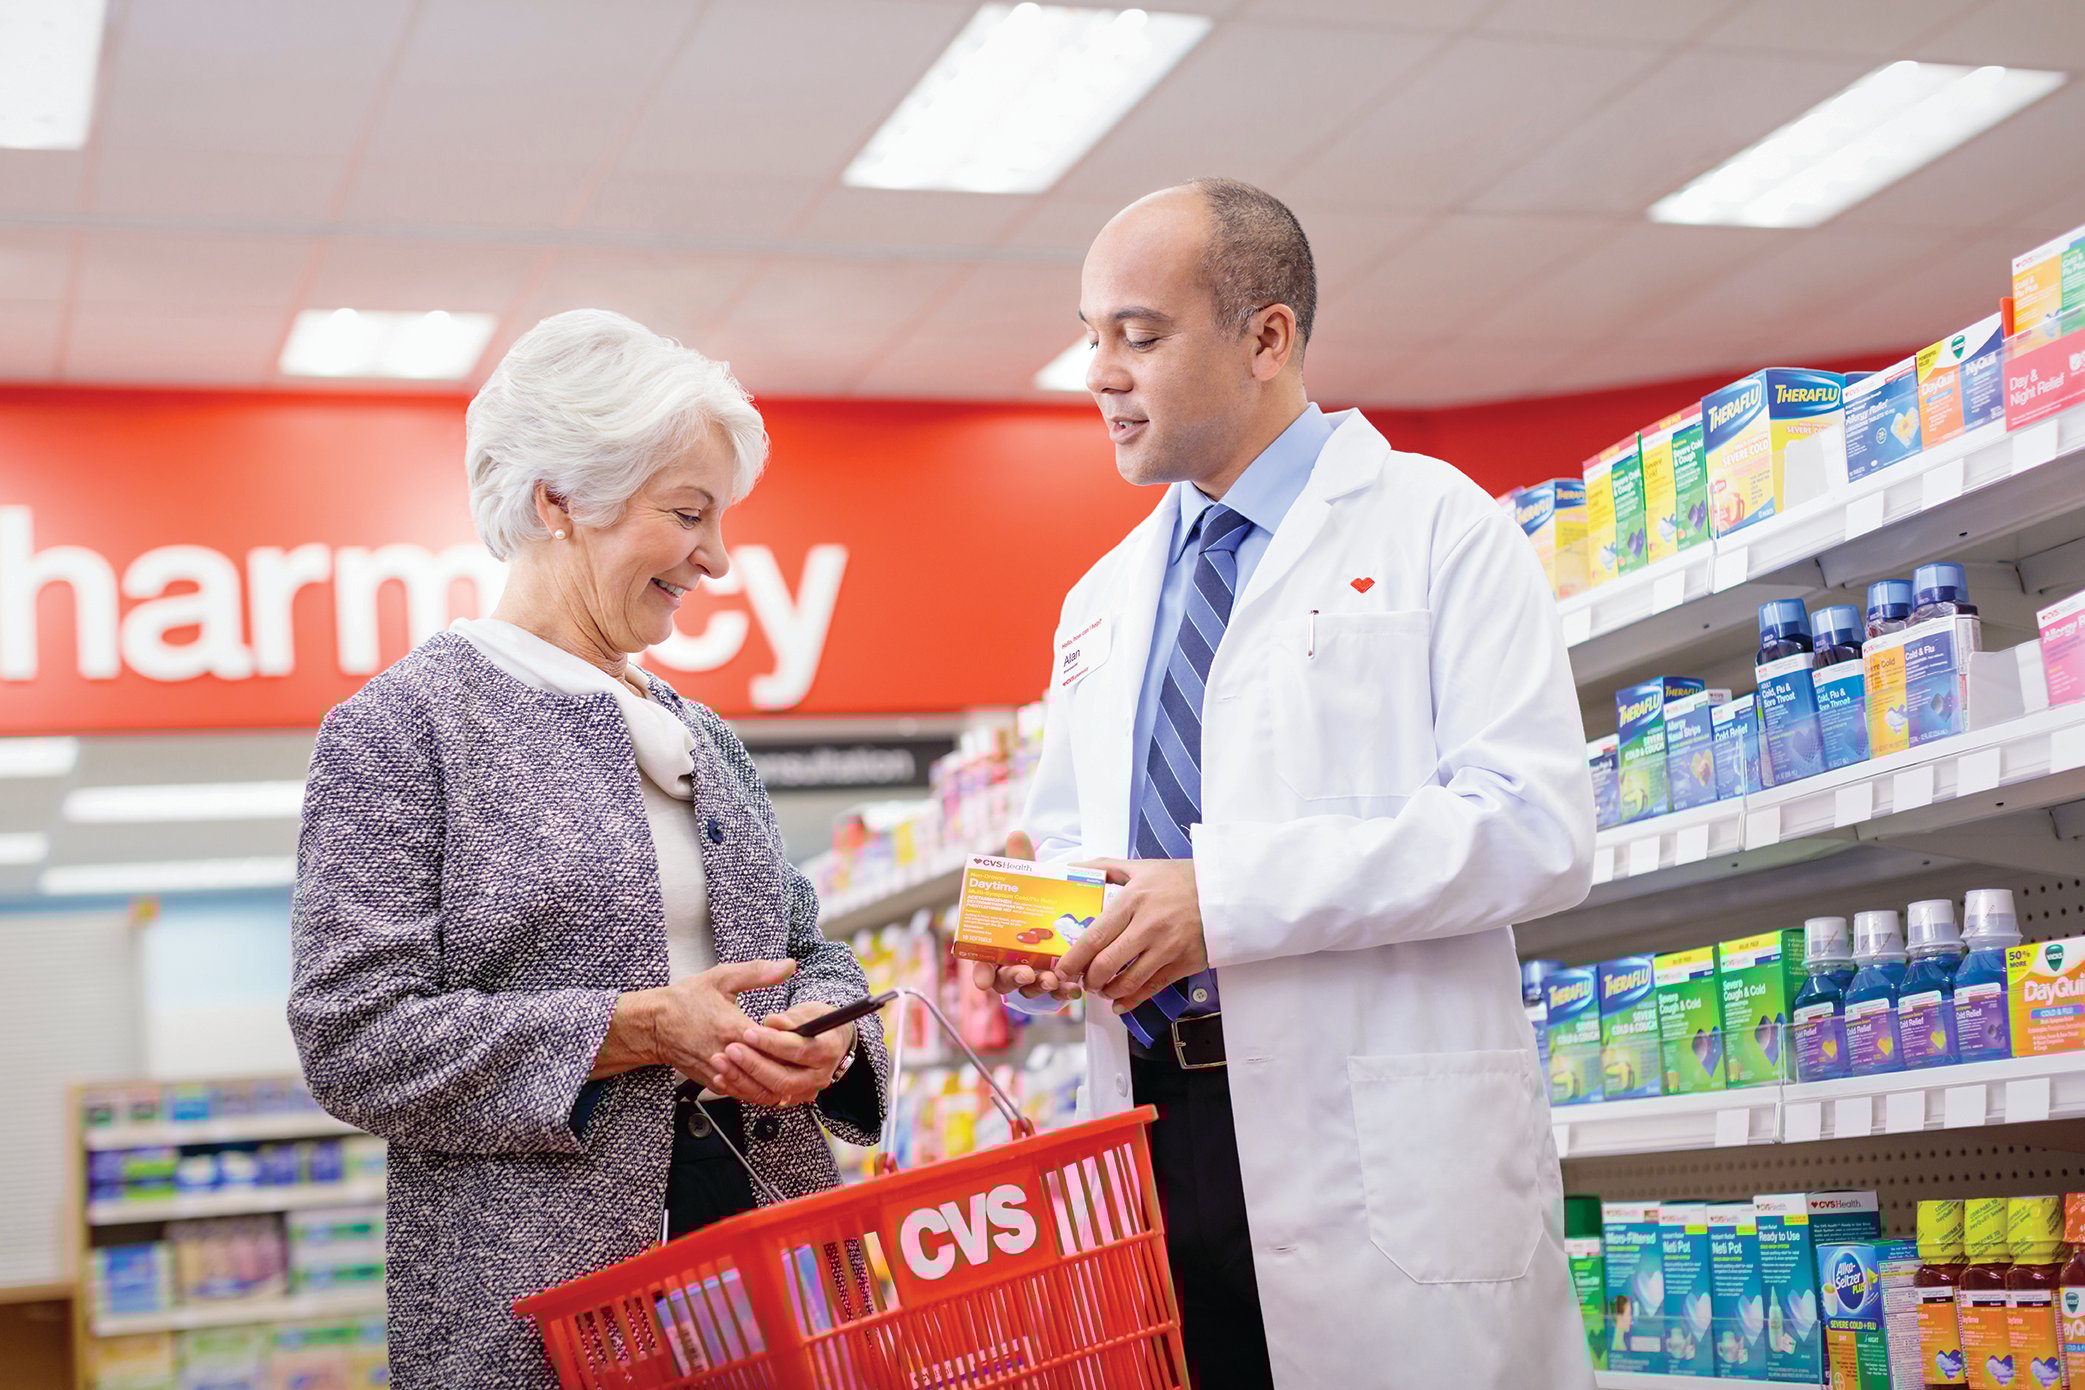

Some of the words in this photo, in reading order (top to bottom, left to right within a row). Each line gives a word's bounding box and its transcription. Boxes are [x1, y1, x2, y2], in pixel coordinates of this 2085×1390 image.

[1965, 351, 1998, 376] NyQuil
[1921, 371, 1955, 396] DayQuil
[2009, 375, 2029, 392] Day
[2030, 368, 2039, 382] &
[1775, 384, 1840, 405] THERAFLU
[2010, 386, 2037, 407] Night
[2037, 372, 2065, 395] Relief
[1707, 385, 1760, 434] THERAFLU
[1845, 409, 1868, 425] Allergy
[1868, 398, 1889, 416] Relief
[1786, 425, 1813, 435] SEVERE
[1722, 447, 1749, 467] SEVERE
[1750, 438, 1769, 456] COLD
[0, 505, 848, 711] harmcy
[2044, 621, 2079, 644] Allergy
[1063, 649, 1081, 667] Alan
[1904, 650, 1918, 661] Cold
[1918, 647, 1924, 657] &
[1924, 645, 1935, 655] Flu
[1761, 689, 1776, 700] Cold,
[1776, 685, 1786, 695] Flu
[1785, 683, 1792, 692] &
[1764, 698, 1776, 708] Sore
[1776, 692, 1796, 704] Throat
[1817, 694, 1830, 704] Cold,
[1830, 690, 1840, 701] Flu
[1839, 688, 1846, 698] &
[1618, 693, 1662, 728] THERAFLU
[1831, 697, 1851, 708] Throat
[1715, 730, 1730, 742] Cold
[1729, 723, 1748, 739] Relief
[968, 877, 1020, 894] Daytime
[2008, 950, 2031, 962] 50%
[2009, 960, 2028, 969] MORE
[1603, 967, 1650, 999] THERAFLU
[1722, 978, 1744, 991] Severe
[1548, 979, 1591, 1010] THERAFLU
[1658, 992, 1679, 1005] Severe
[1723, 989, 1744, 1003] Cough
[1743, 986, 1750, 997] &
[1750, 983, 1766, 996] Cold
[1659, 1003, 1680, 1016] Cough
[1679, 1000, 1685, 1011] &
[1685, 998, 1702, 1010] Cold
[1955, 1011, 1966, 1020] Cold
[1966, 1008, 1982, 1019] Relief
[1846, 1026, 1857, 1036] Cold
[1857, 1023, 1872, 1034] Relief
[1899, 1019, 1909, 1029] Cold
[1909, 1016, 1924, 1027] Relief
[1803, 1027, 1818, 1037] Relief
[900, 1184, 1037, 1280] CVS
[1758, 1230, 1778, 1244] Ready
[1778, 1231, 1786, 1241] to
[1786, 1230, 1801, 1241] Use
[1663, 1241, 1678, 1253] Neti
[1678, 1240, 1691, 1254] Pot
[1712, 1241, 1728, 1255] Neti
[1728, 1241, 1743, 1255] Pot
[1836, 1261, 1856, 1278] Alka-
[1835, 1272, 1862, 1290] Seltzer
[1852, 1283, 1865, 1295] PLUS
[1830, 1320, 1849, 1330] SEVERE
